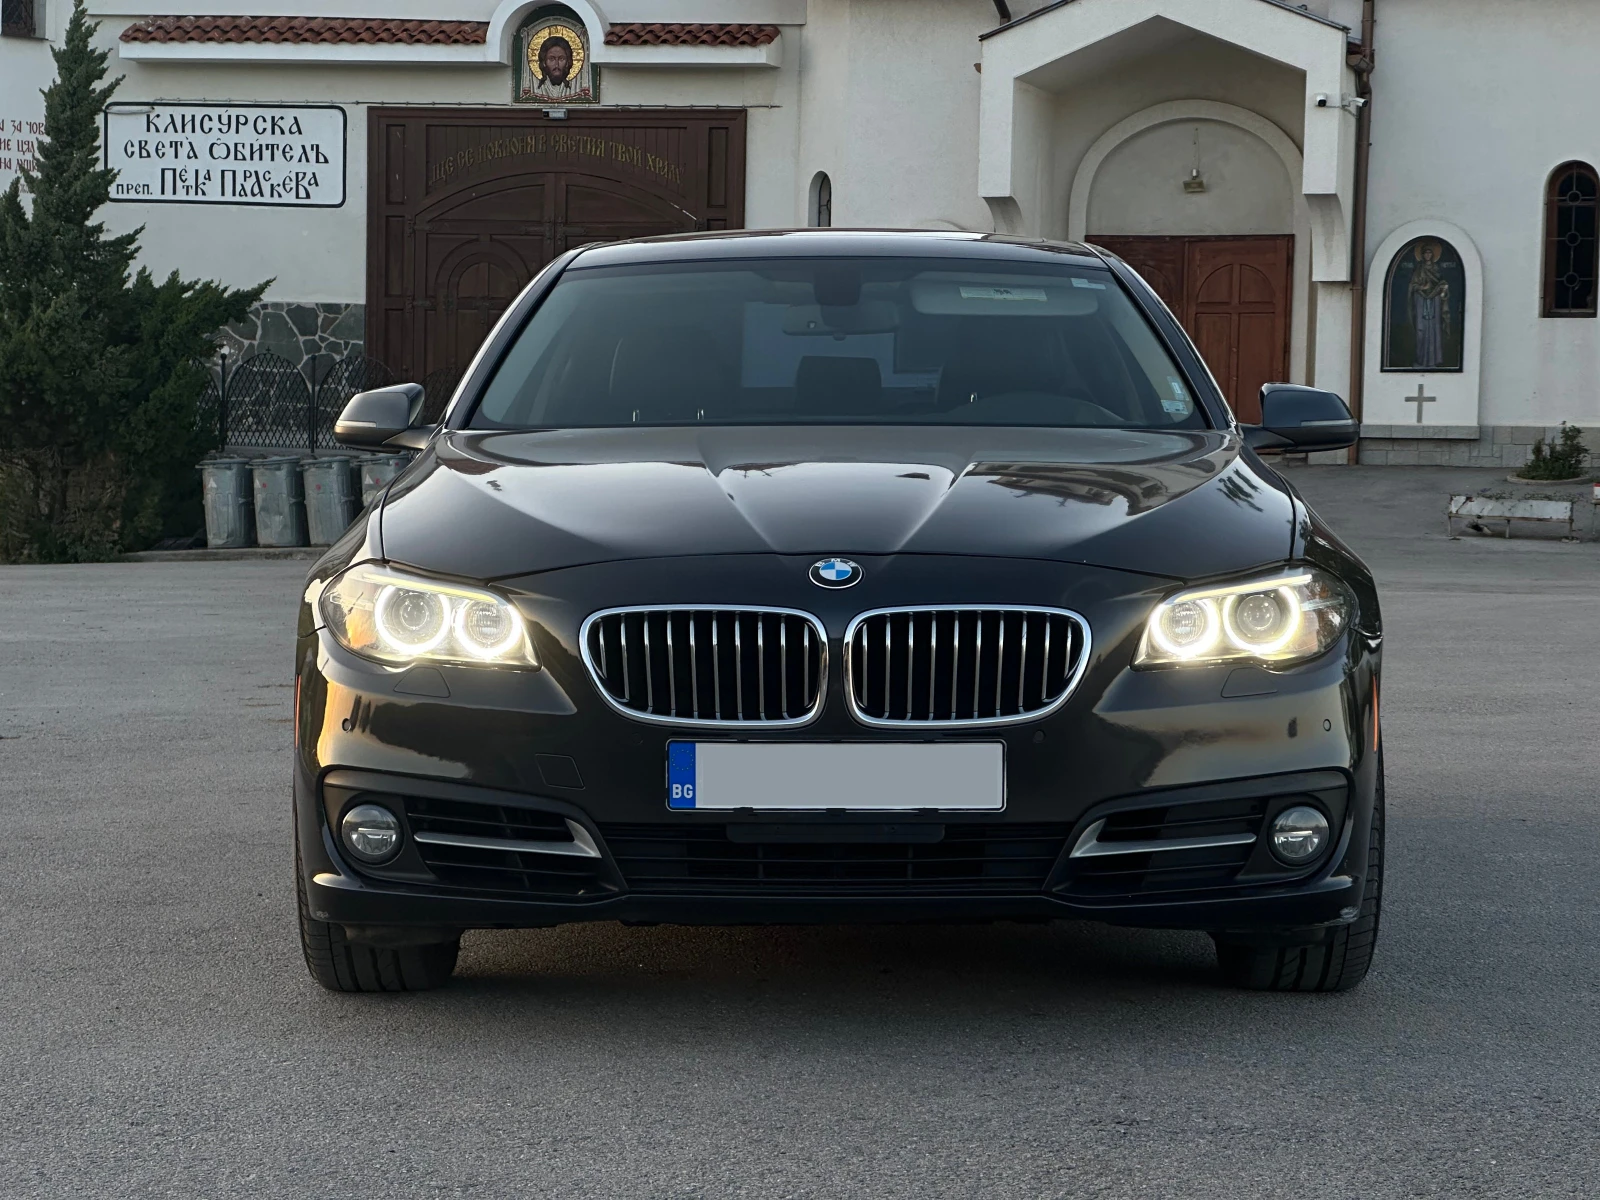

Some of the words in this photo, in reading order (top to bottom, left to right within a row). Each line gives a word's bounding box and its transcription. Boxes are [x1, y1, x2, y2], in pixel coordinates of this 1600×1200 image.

[26, 121, 45, 136] ЧОВ
[457, 148, 474, 167] СЕ
[477, 134, 536, 164] ПОКЛОНЯ
[672, 783, 694, 799] BG
